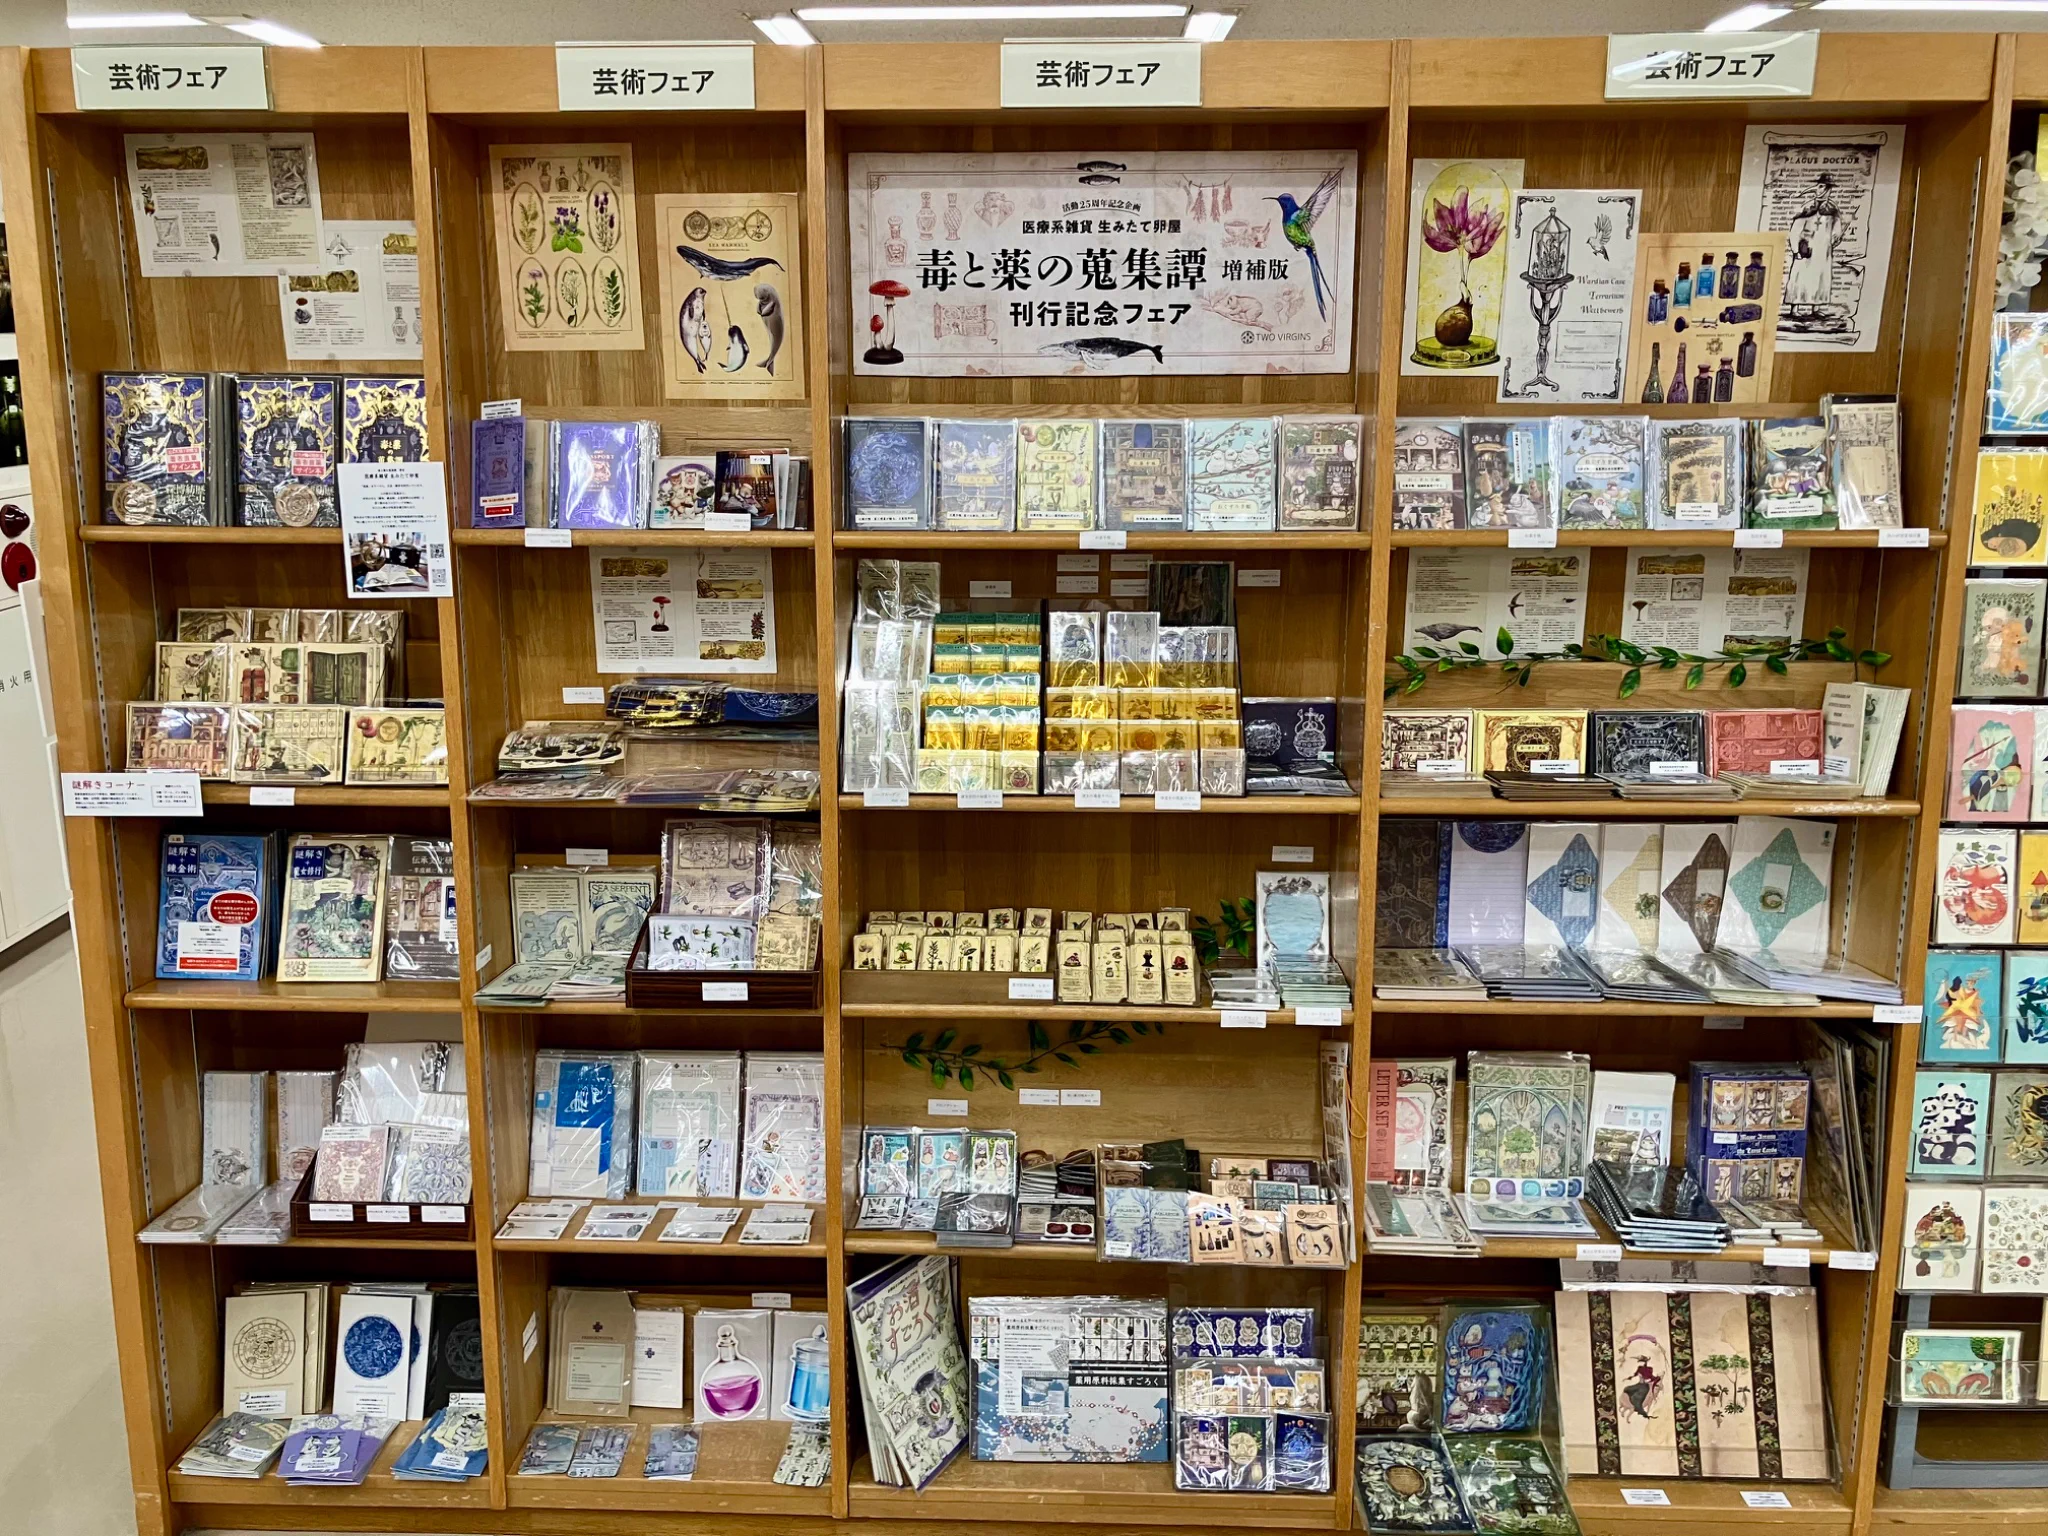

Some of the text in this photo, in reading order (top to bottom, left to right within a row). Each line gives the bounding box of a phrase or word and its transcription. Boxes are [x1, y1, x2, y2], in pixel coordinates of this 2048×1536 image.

[1645, 50, 1776, 81] 芸術フェア
[108, 63, 228, 91] 芸術フェア
[593, 68, 715, 95] 芸術フェア
[1036, 60, 1161, 88] 芸術フェア
[1822, 157, 1860, 165] DOCTOR
[1062, 199, 1141, 213] 活動25周年記念企画
[1022, 219, 1182, 235] 医療系雑貨 生みたて卵屋
[915, 247, 1289, 292] 毒と薬の蒐集譚 増補版
[1010, 301, 1192, 328] 刊行記念フェア
[1255, 331, 1311, 342] TWO VIRGINS
[72, 780, 145, 790] 謎解きコーナー
[168, 846, 197, 857] 謎解き
[295, 849, 323, 859] 謎解き
[167, 863, 197, 874] 錬金術
[592, 884, 649, 895] SEA SERPENT
[1376, 1069, 1391, 1107] LETTER
[1376, 1109, 1389, 1128] SET
[1075, 1375, 1160, 1387] 薬用原料採集すごろく
